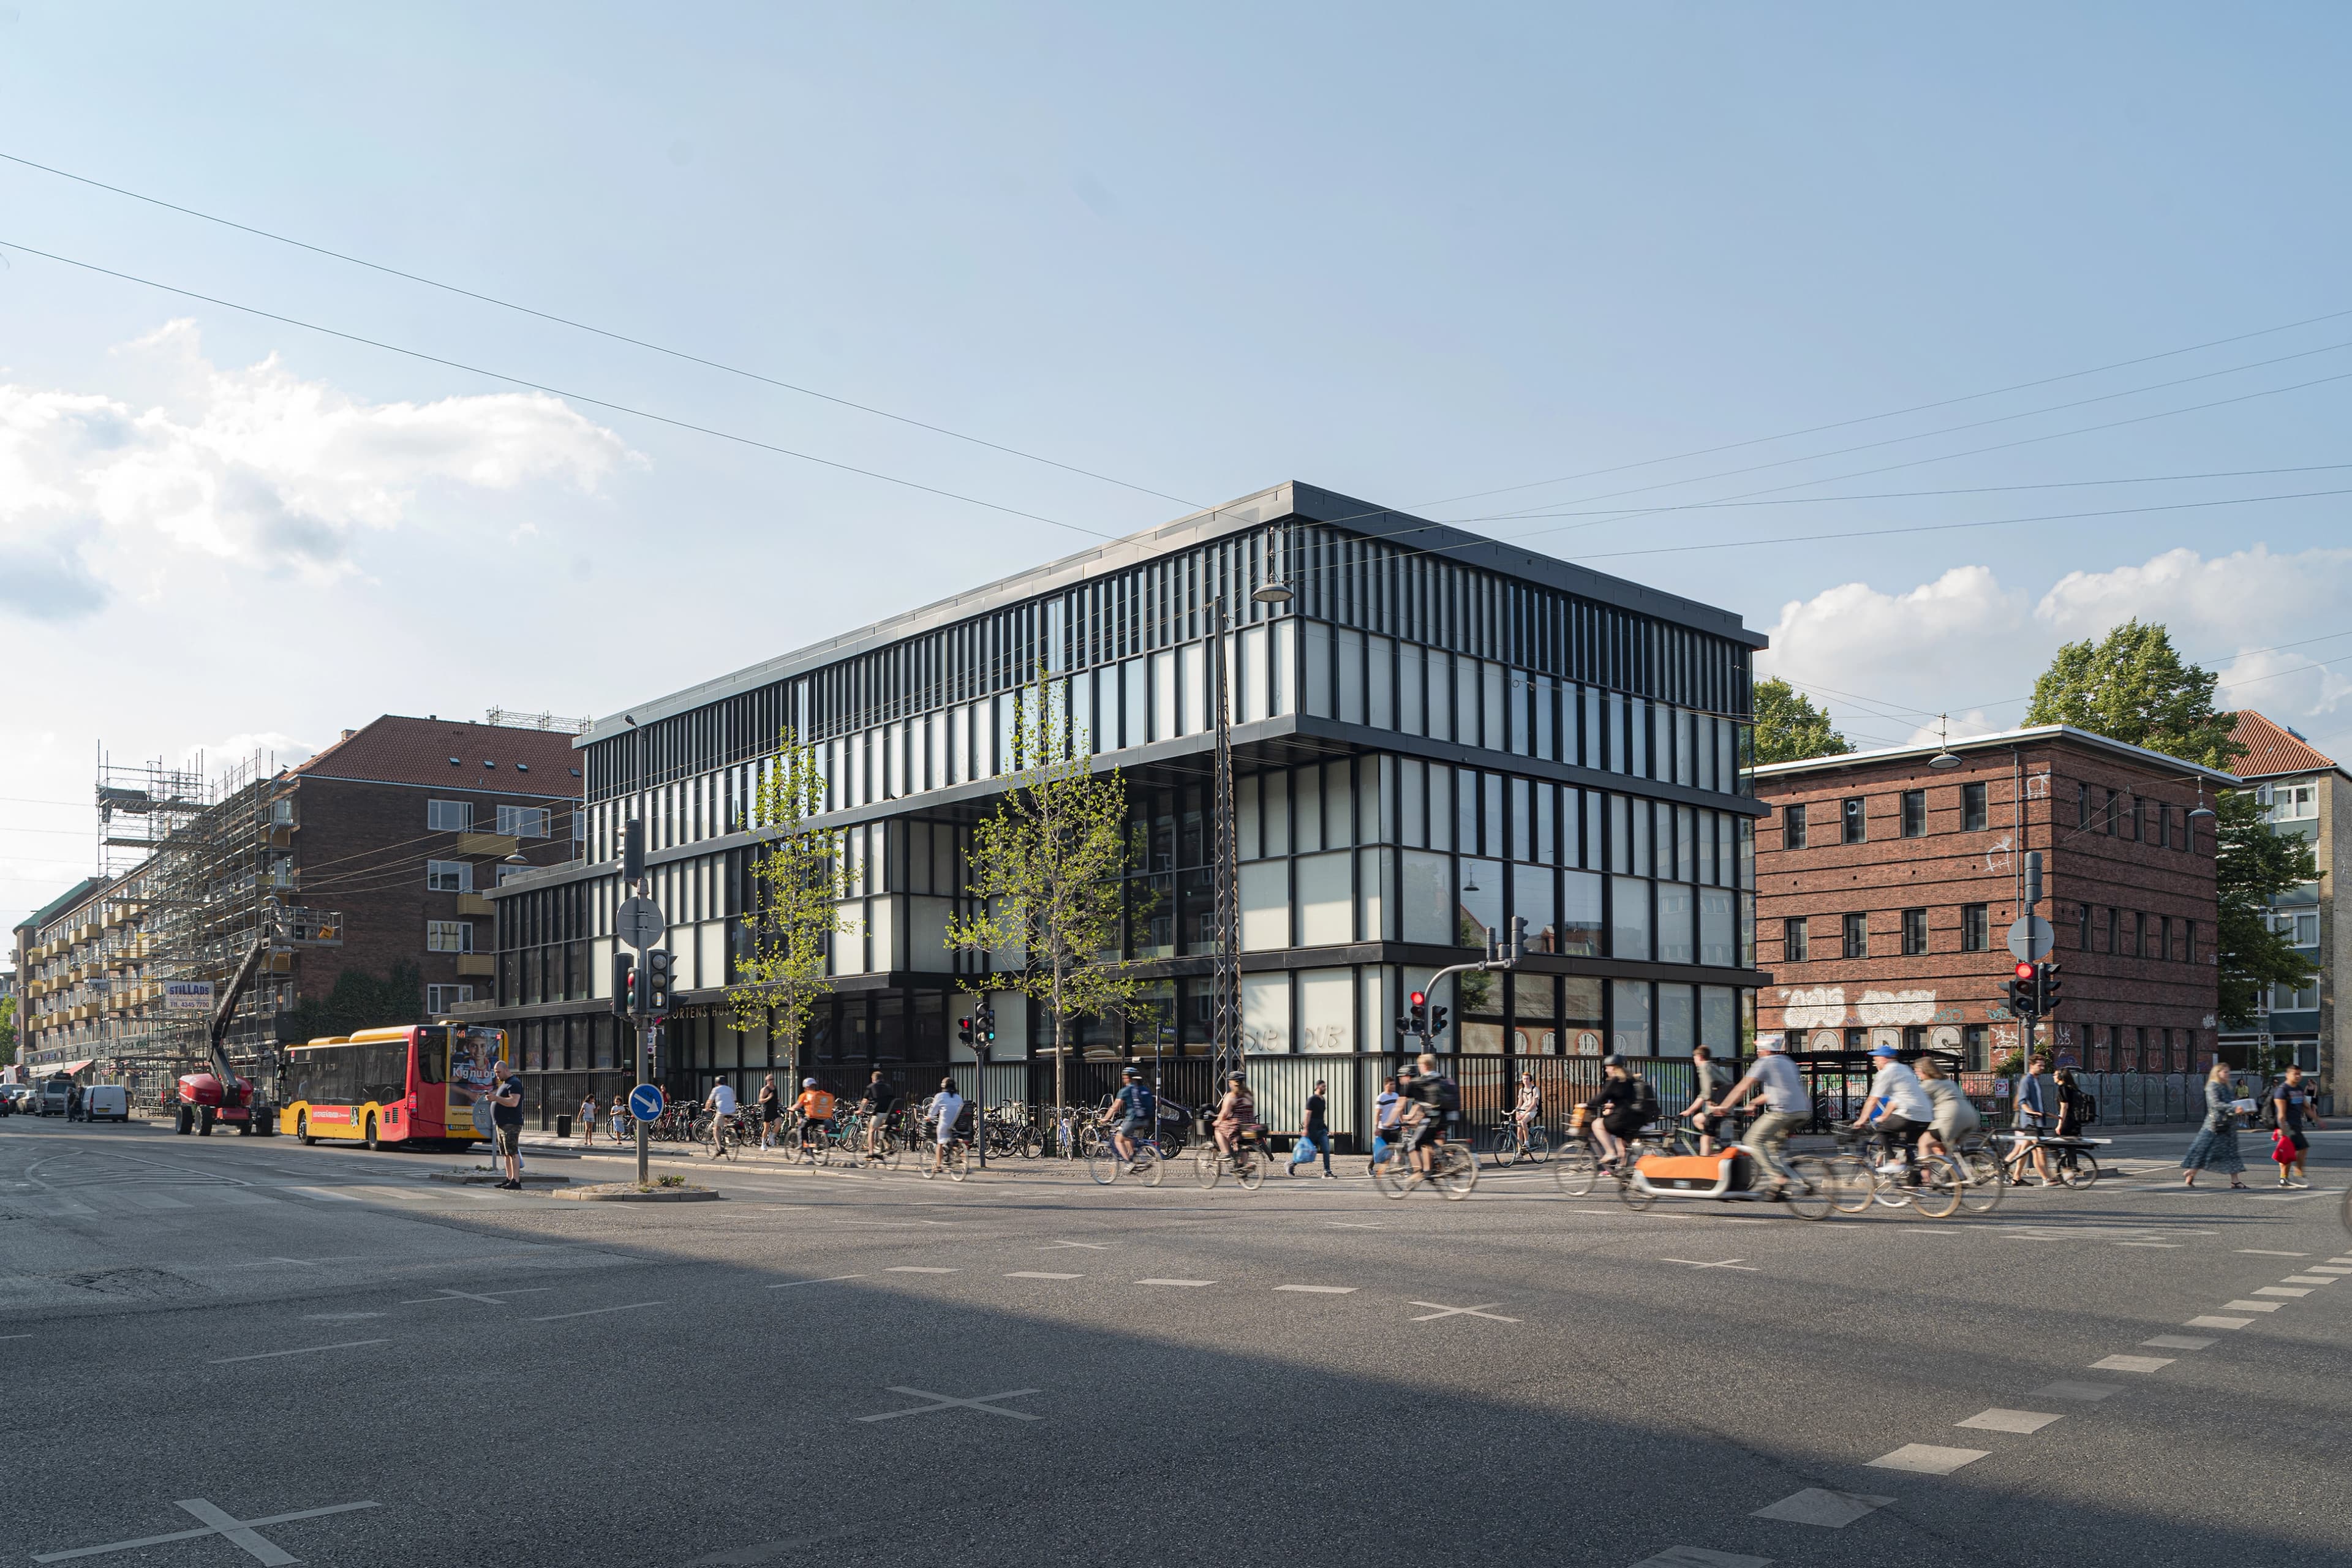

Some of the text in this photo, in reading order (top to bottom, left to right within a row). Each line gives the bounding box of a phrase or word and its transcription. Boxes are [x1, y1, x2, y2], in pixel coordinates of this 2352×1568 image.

[712, 1005, 729, 1017] HUS
[457, 1030, 466, 1039] 4A
[453, 1068, 469, 1079] Kig
[470, 1070, 483, 1079] nu
